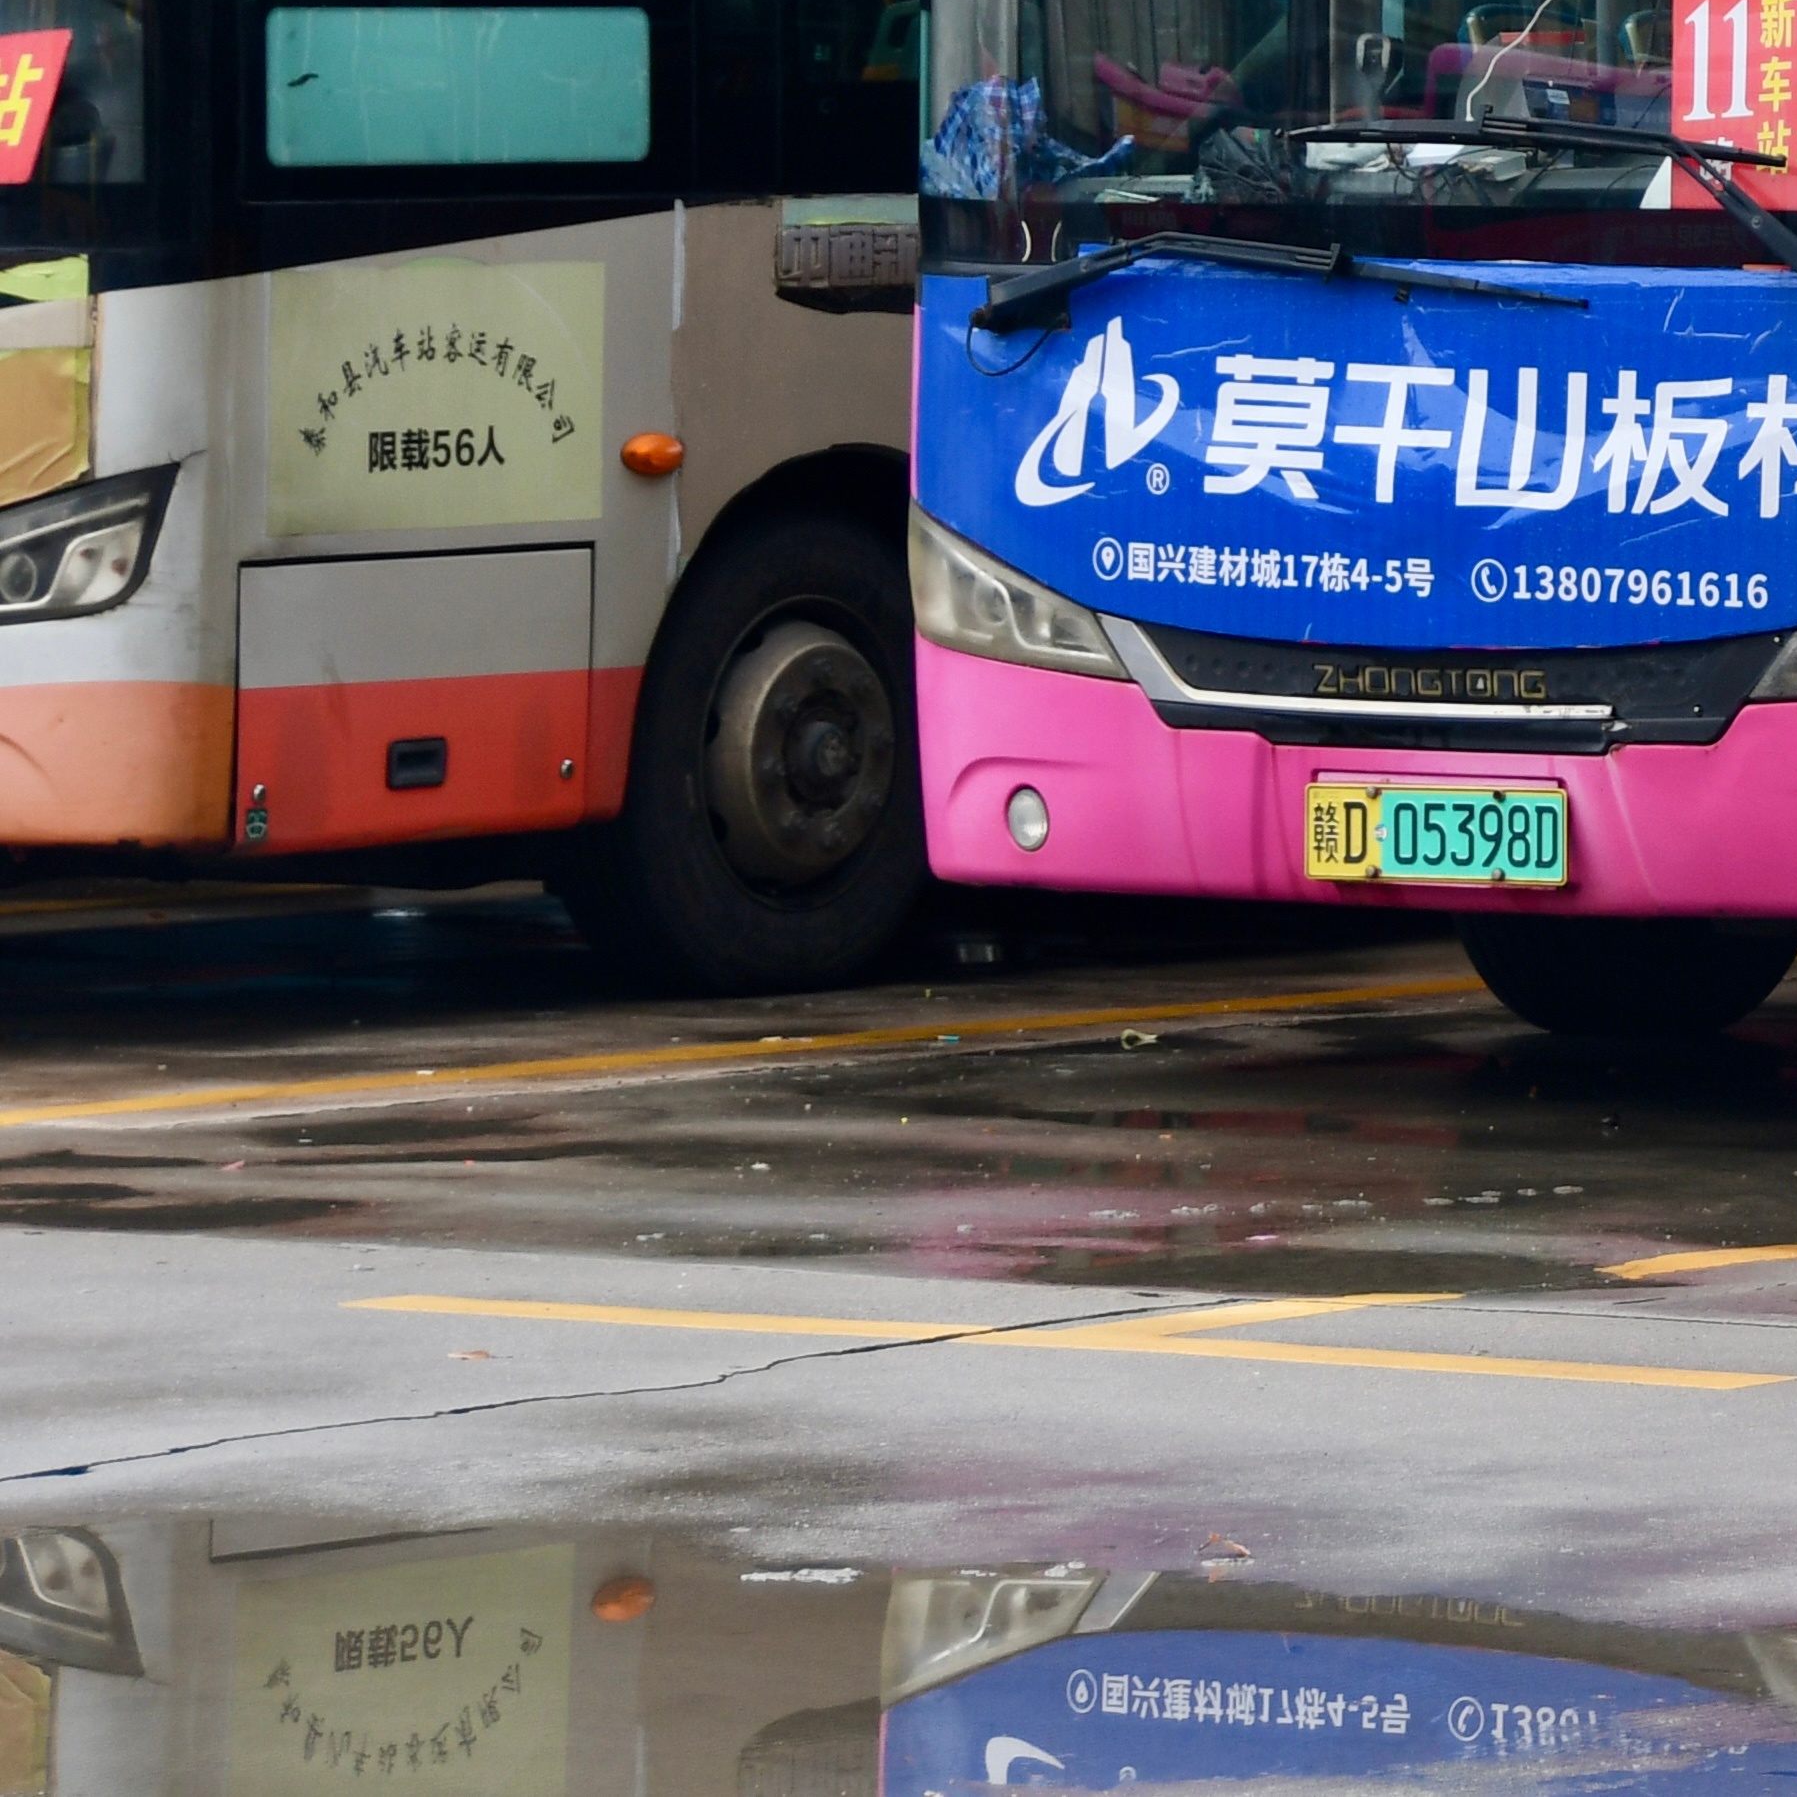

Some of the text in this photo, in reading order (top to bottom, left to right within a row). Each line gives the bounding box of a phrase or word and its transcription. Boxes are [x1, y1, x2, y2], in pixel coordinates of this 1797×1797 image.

[299, 323, 576, 457] 泰和县汽车站客运有限公司
[367, 425, 505, 474] 限载56人
[1126, 540, 1435, 600] 国兴建材城17栋4-5号
[1511, 562, 1770, 612] 13807961616
[1313, 664, 1547, 700] ZHONGTONG
[1312, 801, 1559, 869] 赣D 05398D
